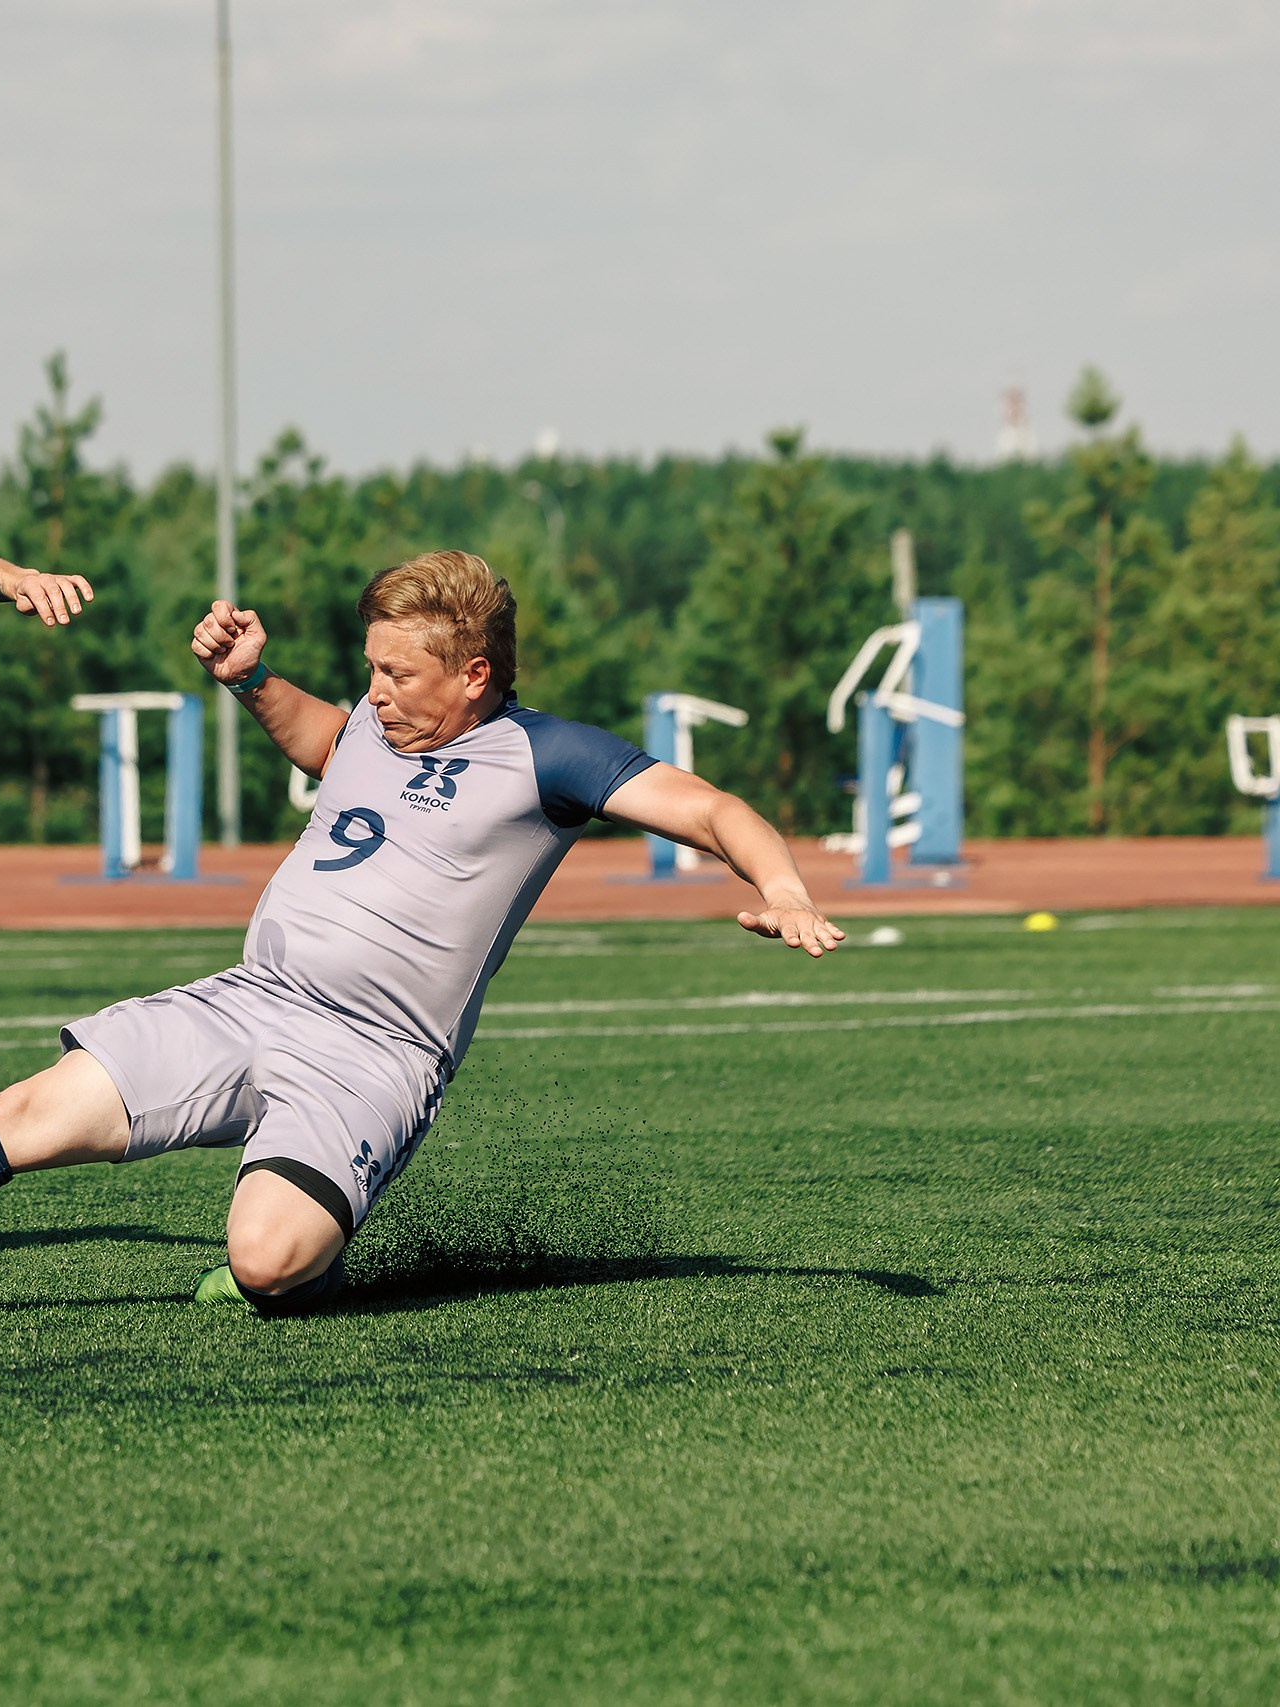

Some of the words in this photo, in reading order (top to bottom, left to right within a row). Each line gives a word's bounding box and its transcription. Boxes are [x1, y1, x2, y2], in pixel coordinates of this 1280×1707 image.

[399, 790, 451, 811] КОМОС
[409, 803, 431, 814] ГРУПП
[313, 807, 386, 871] 9
